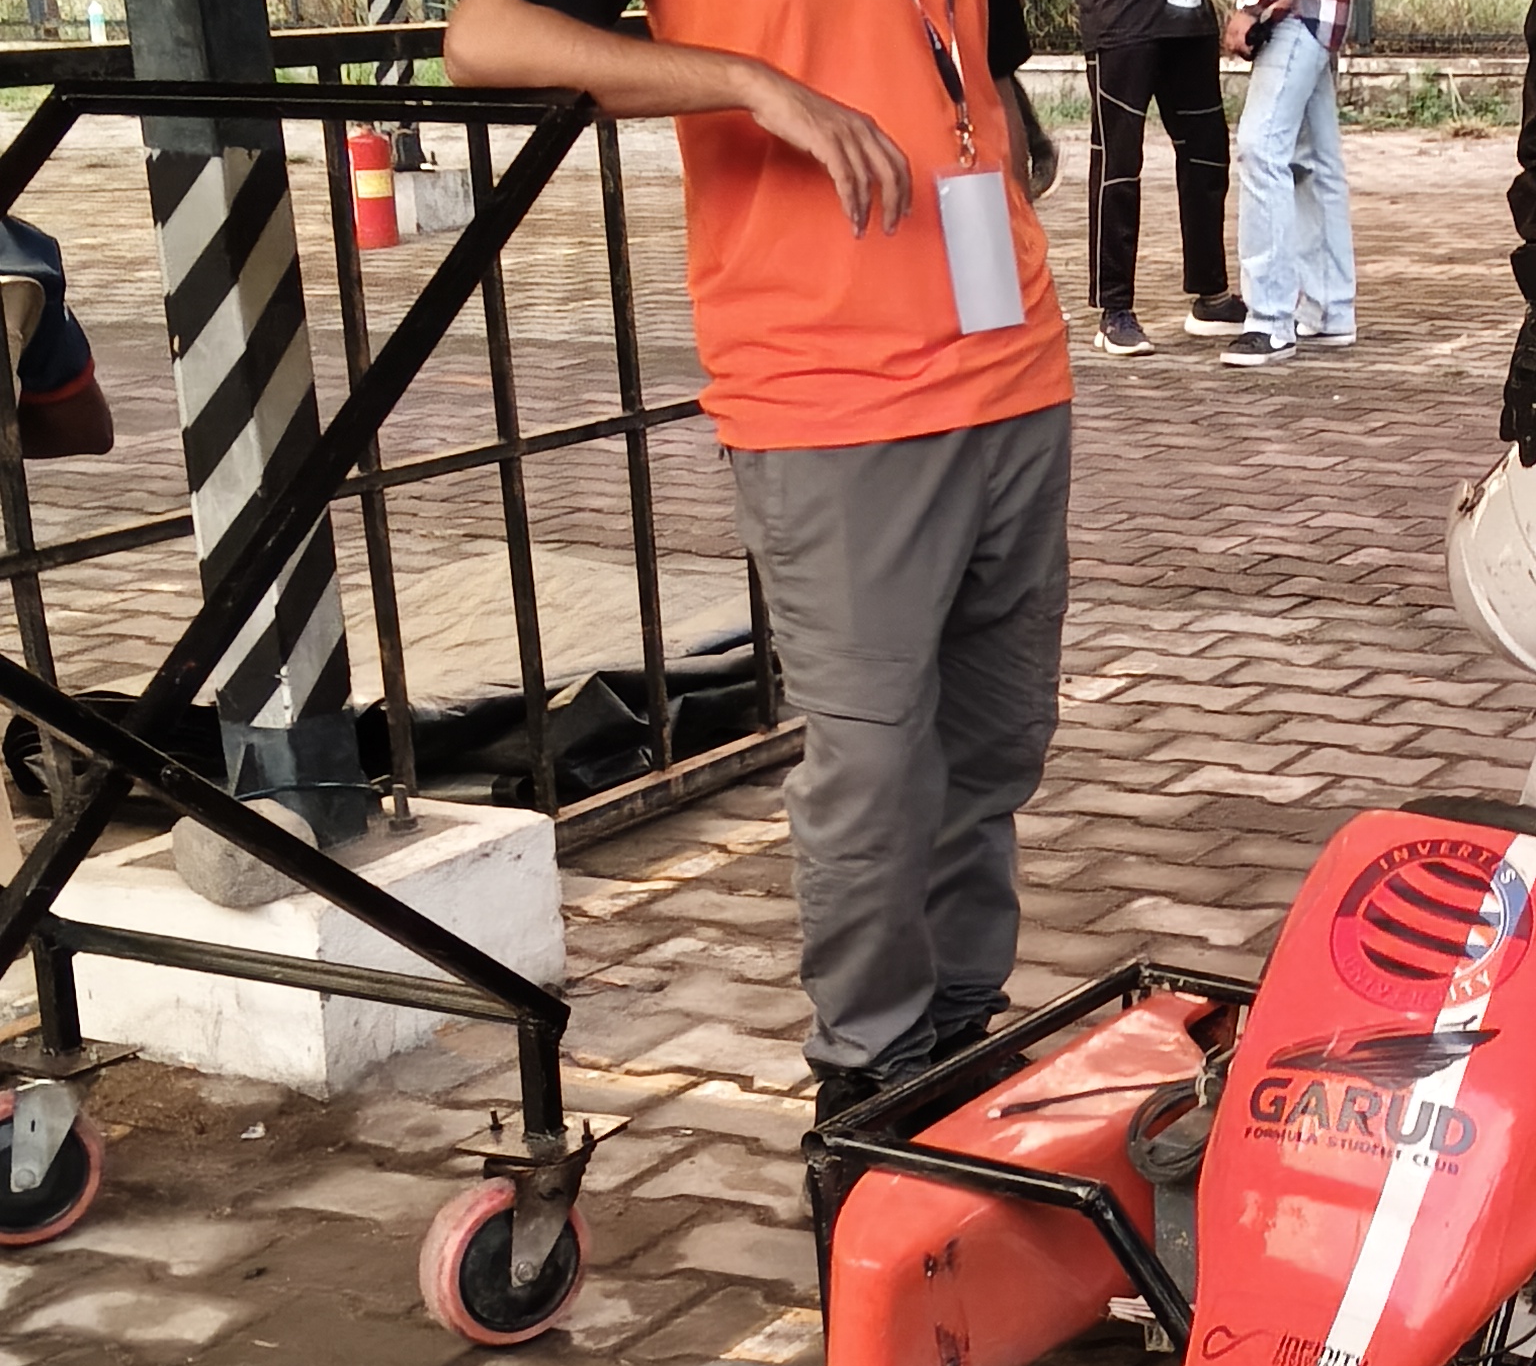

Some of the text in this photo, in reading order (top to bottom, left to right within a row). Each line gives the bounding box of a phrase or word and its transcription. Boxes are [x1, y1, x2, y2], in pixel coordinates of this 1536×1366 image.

[1249, 1077, 1478, 1157] GARUD
[1244, 1125, 1460, 1176] FORMULA STUDENT CLUB
